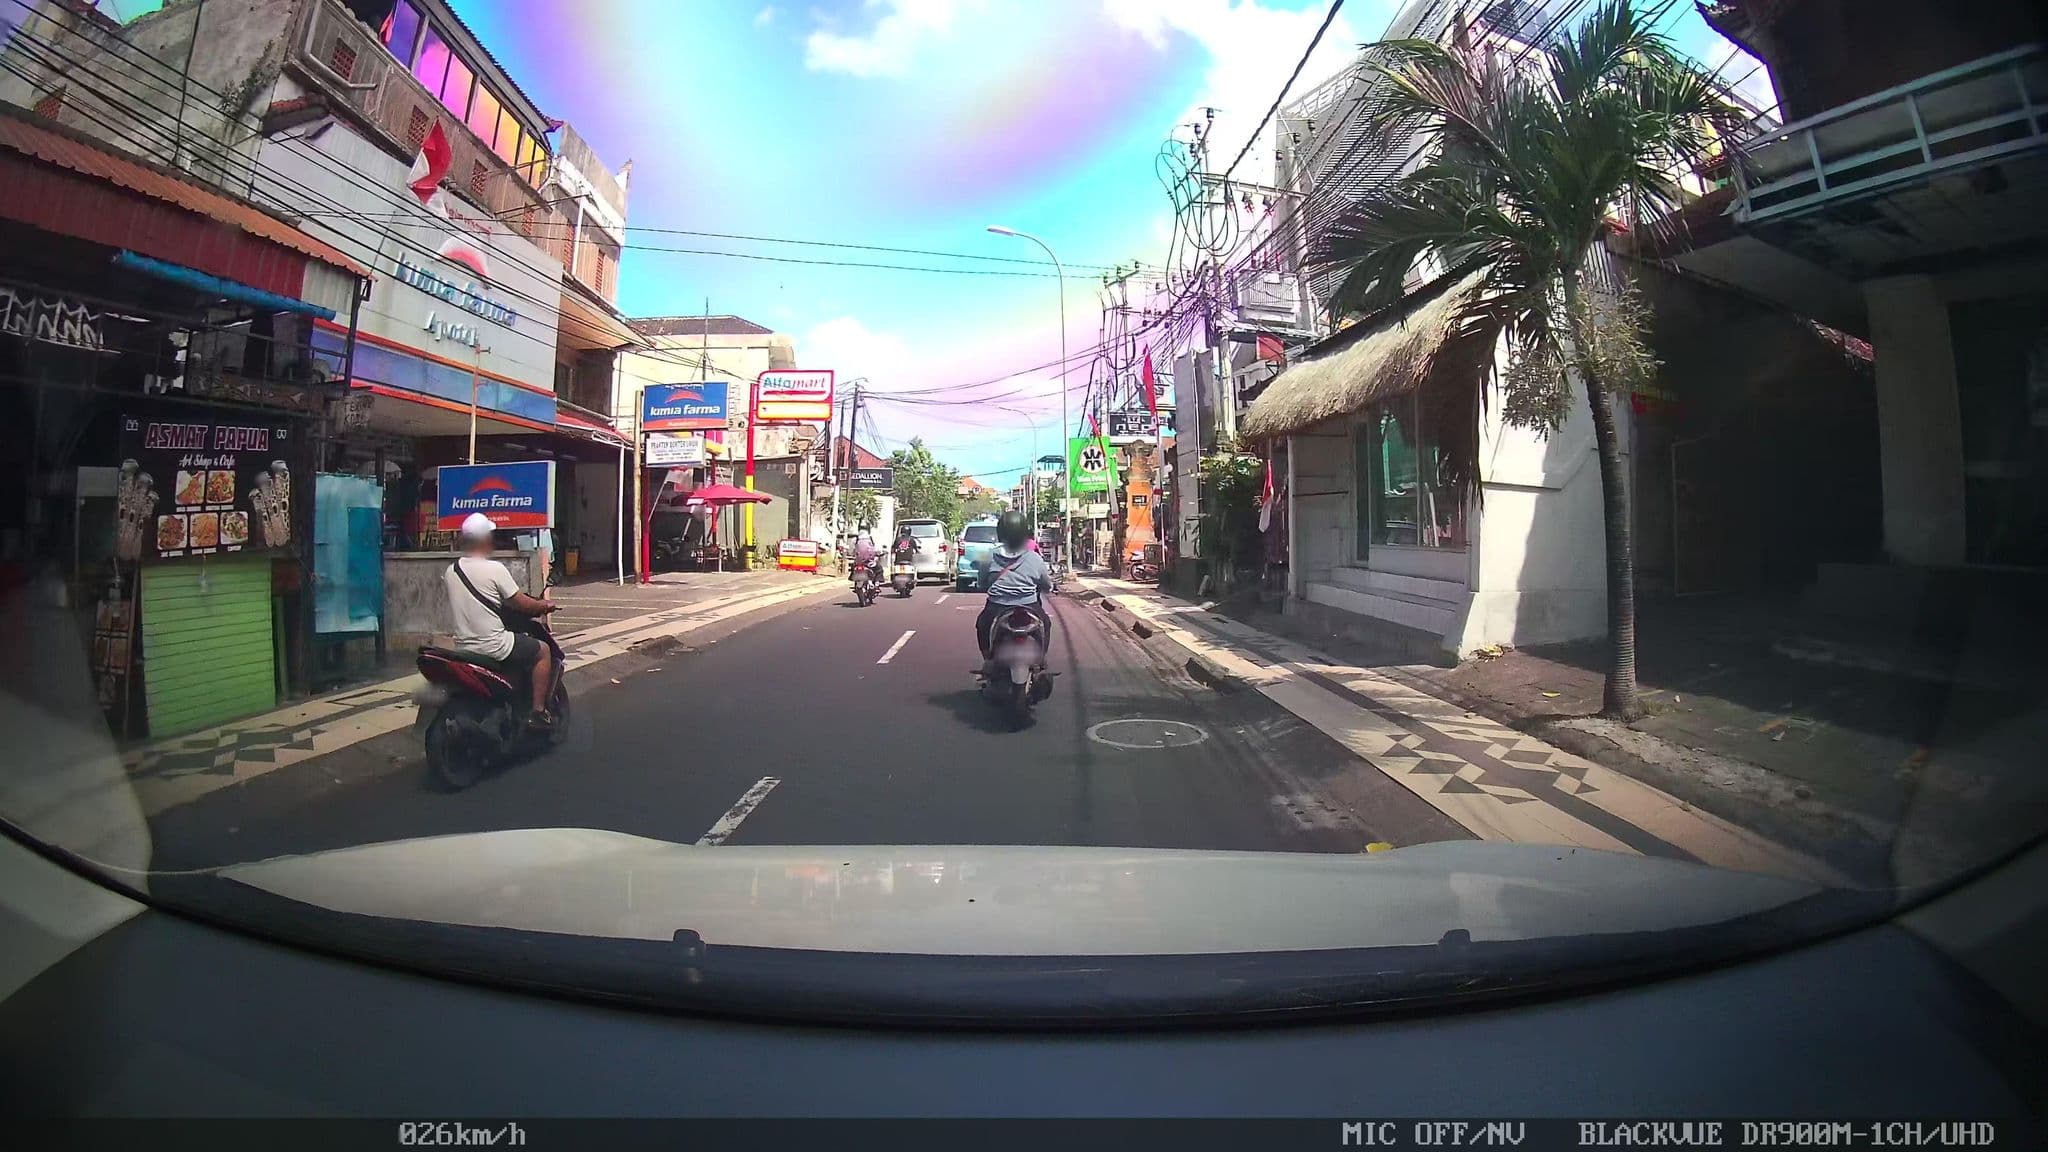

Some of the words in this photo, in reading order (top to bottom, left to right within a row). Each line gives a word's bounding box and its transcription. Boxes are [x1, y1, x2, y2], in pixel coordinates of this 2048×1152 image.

[394, 251, 456, 301] kimia
[763, 376, 826, 389] Alfamart
[650, 406, 682, 416] kimia
[683, 404, 721, 415] farma
[145, 423, 208, 449] ASMAT
[214, 426, 269, 450] PAPUA
[193, 454, 213, 469] Shop
[452, 497, 488, 509] kimia
[491, 495, 532, 507] farma
